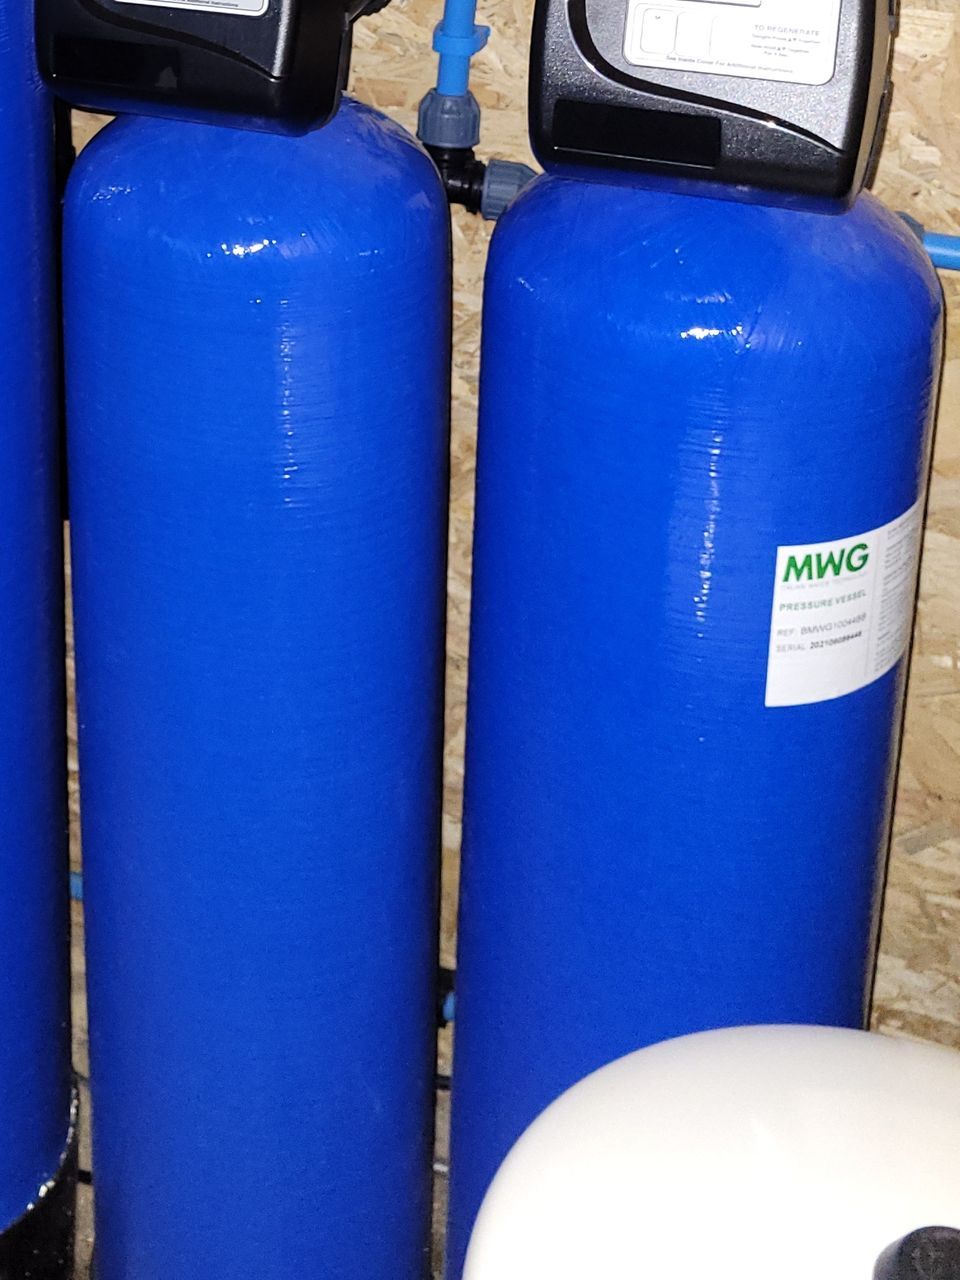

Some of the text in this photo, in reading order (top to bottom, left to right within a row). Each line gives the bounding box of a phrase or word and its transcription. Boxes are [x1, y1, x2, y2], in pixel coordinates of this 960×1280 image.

[783, 543, 869, 583] MWG
[779, 589, 866, 611] PRESSURE VESSEL
